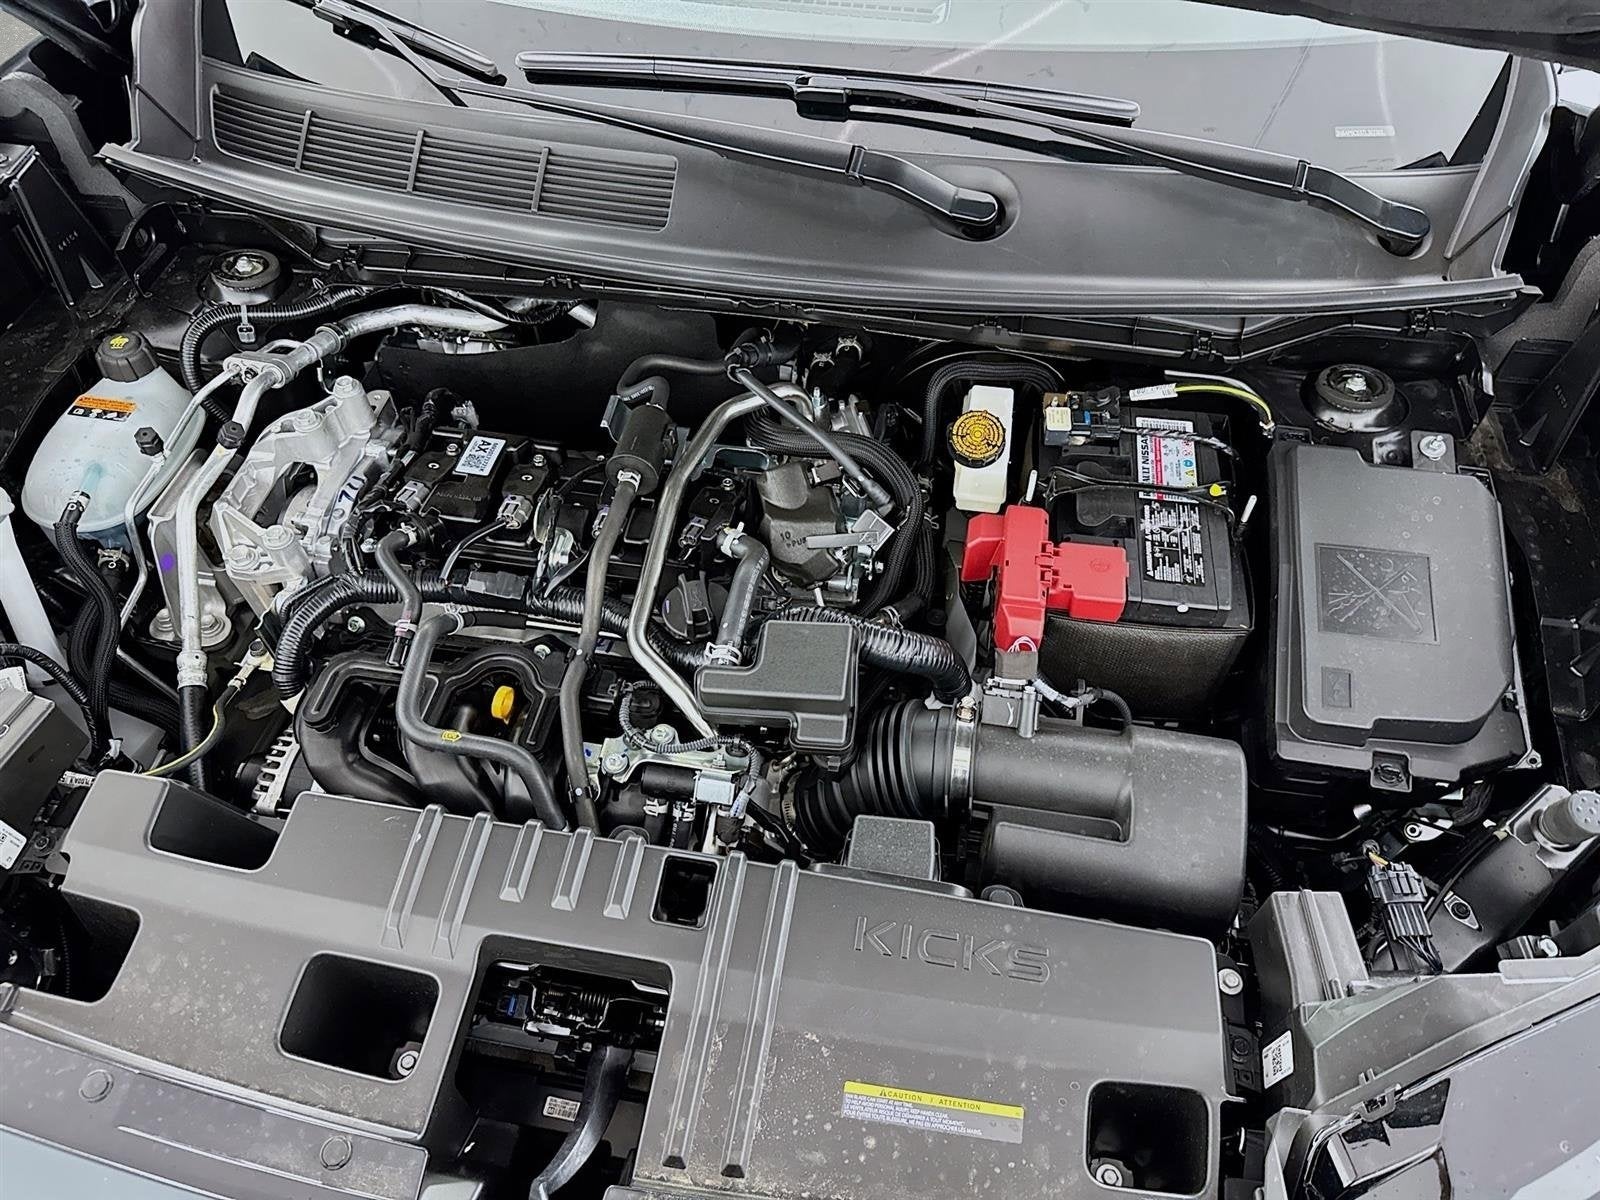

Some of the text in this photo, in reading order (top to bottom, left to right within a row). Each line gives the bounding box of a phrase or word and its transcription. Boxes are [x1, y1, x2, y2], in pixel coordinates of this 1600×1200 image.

[476, 440, 492, 453] AX
[854, 916, 1050, 984] KICKS
[887, 1091, 922, 1102] CAUTION
[938, 1098, 981, 1111] ATTENTION
